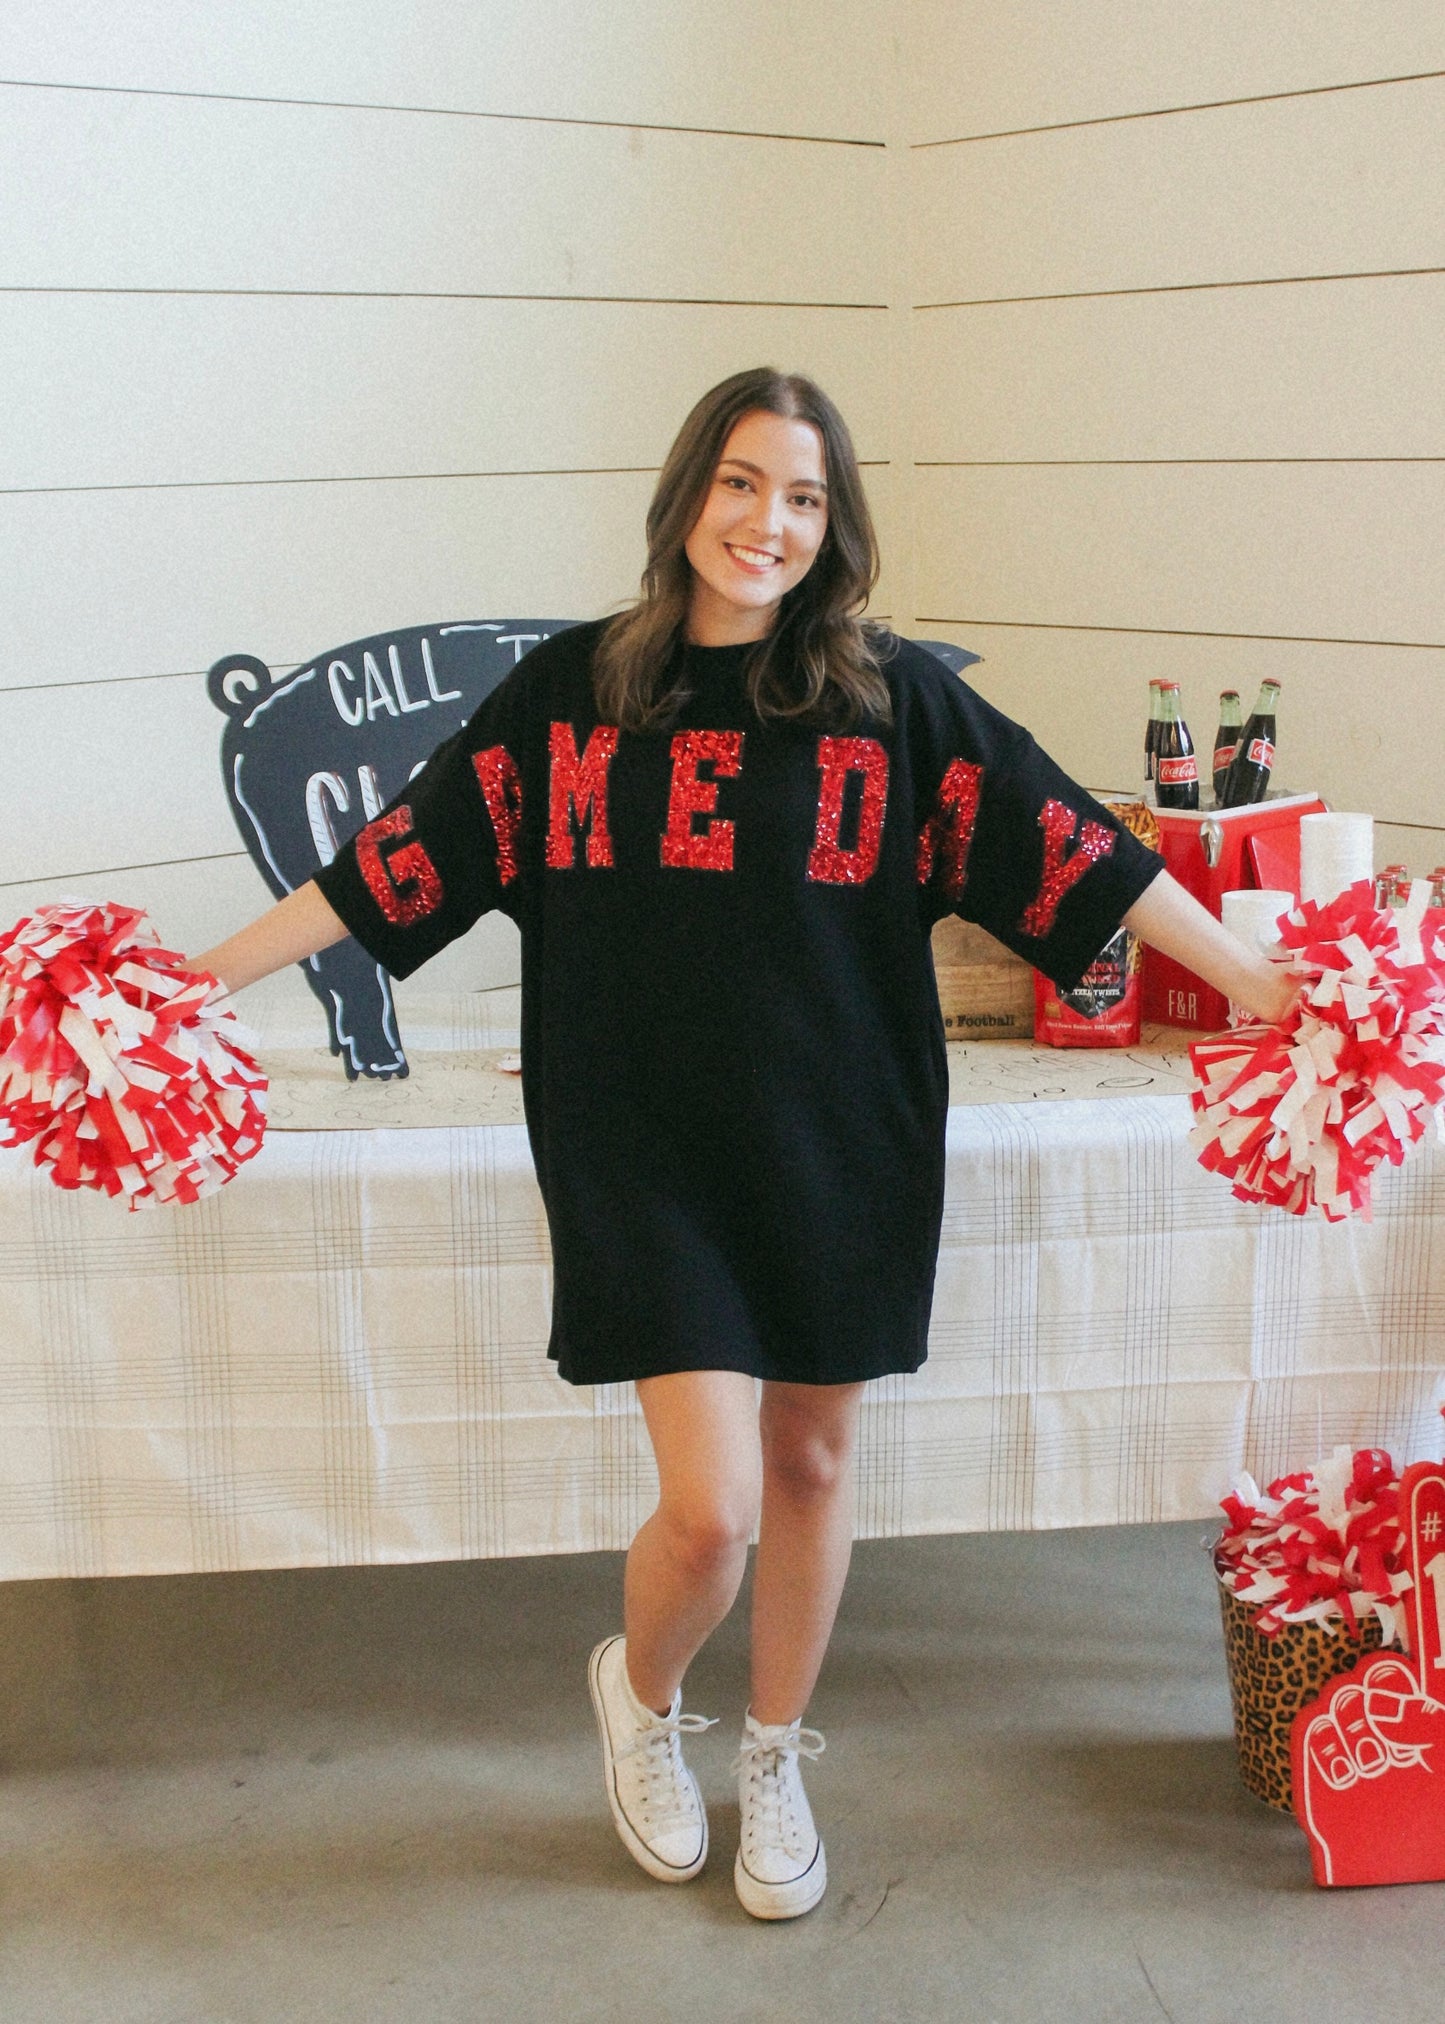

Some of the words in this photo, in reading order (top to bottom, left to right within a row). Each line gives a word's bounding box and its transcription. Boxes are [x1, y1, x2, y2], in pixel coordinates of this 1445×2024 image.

[327, 638, 463, 727] CALL
[956, 1014, 1016, 1028] Football
[1420, 1511, 1443, 1542] #
